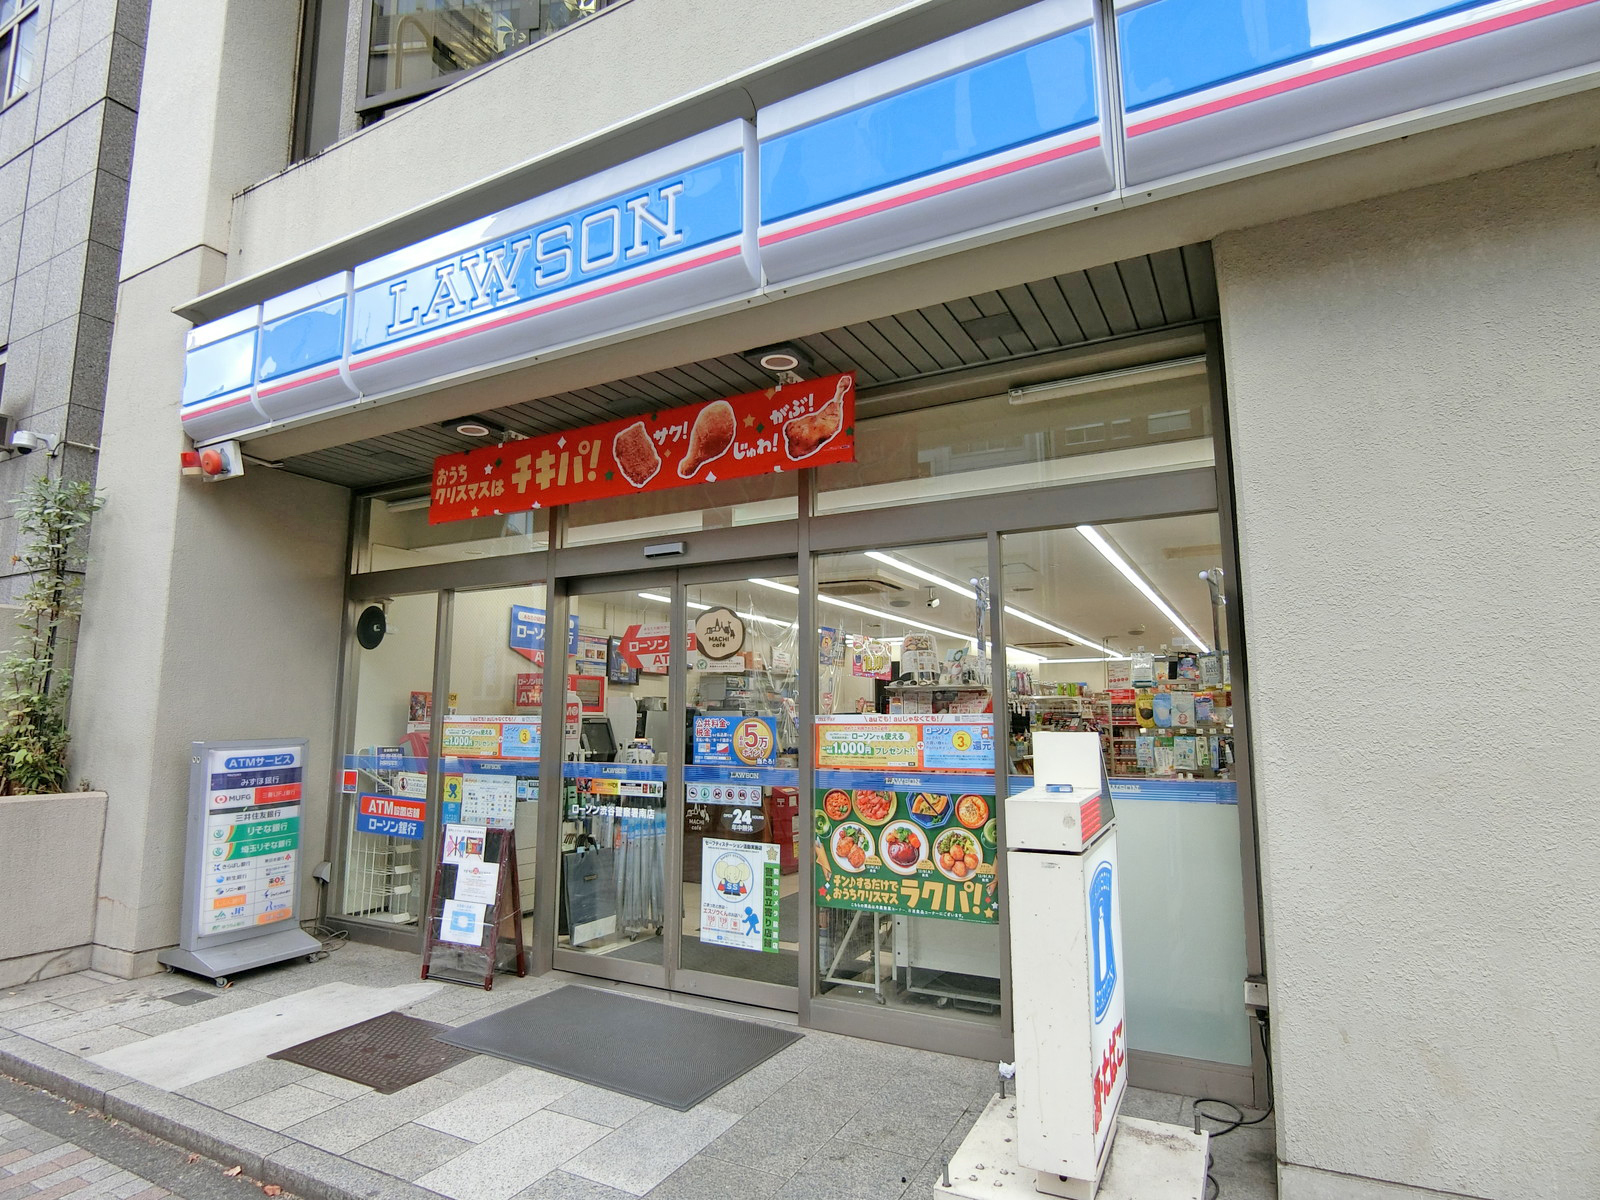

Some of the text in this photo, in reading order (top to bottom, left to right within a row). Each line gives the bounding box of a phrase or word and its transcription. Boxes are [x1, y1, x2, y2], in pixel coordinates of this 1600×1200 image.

[387, 180, 685, 336] LAWSON
[769, 392, 815, 426] がぶ!
[652, 421, 689, 447] サク!
[732, 432, 779, 461] じゅわ!
[436, 463, 469, 487] おうち
[511, 439, 602, 494] チキパ!
[434, 479, 506, 506] クリスマスは
[228, 755, 292, 768] ATMサービス
[741, 747, 765, 758] ポイント
[240, 776, 280, 787] みずほ銀行
[730, 771, 760, 780] LAWSON
[229, 793, 252, 802] MUFG
[235, 809, 281, 822] 三井住友銀行
[368, 799, 421, 819] ATM設置店舗
[572, 804, 656, 820] ローソン渋谷警察署南店
[732, 808, 753, 825] 24
[247, 822, 288, 836] りそな銀行
[368, 818, 417, 836] ローソン銀行
[240, 839, 292, 854] 埼玉りそな銀行
[833, 887, 899, 905] おうちクリスマス
[901, 879, 983, 914] ラクパ!
